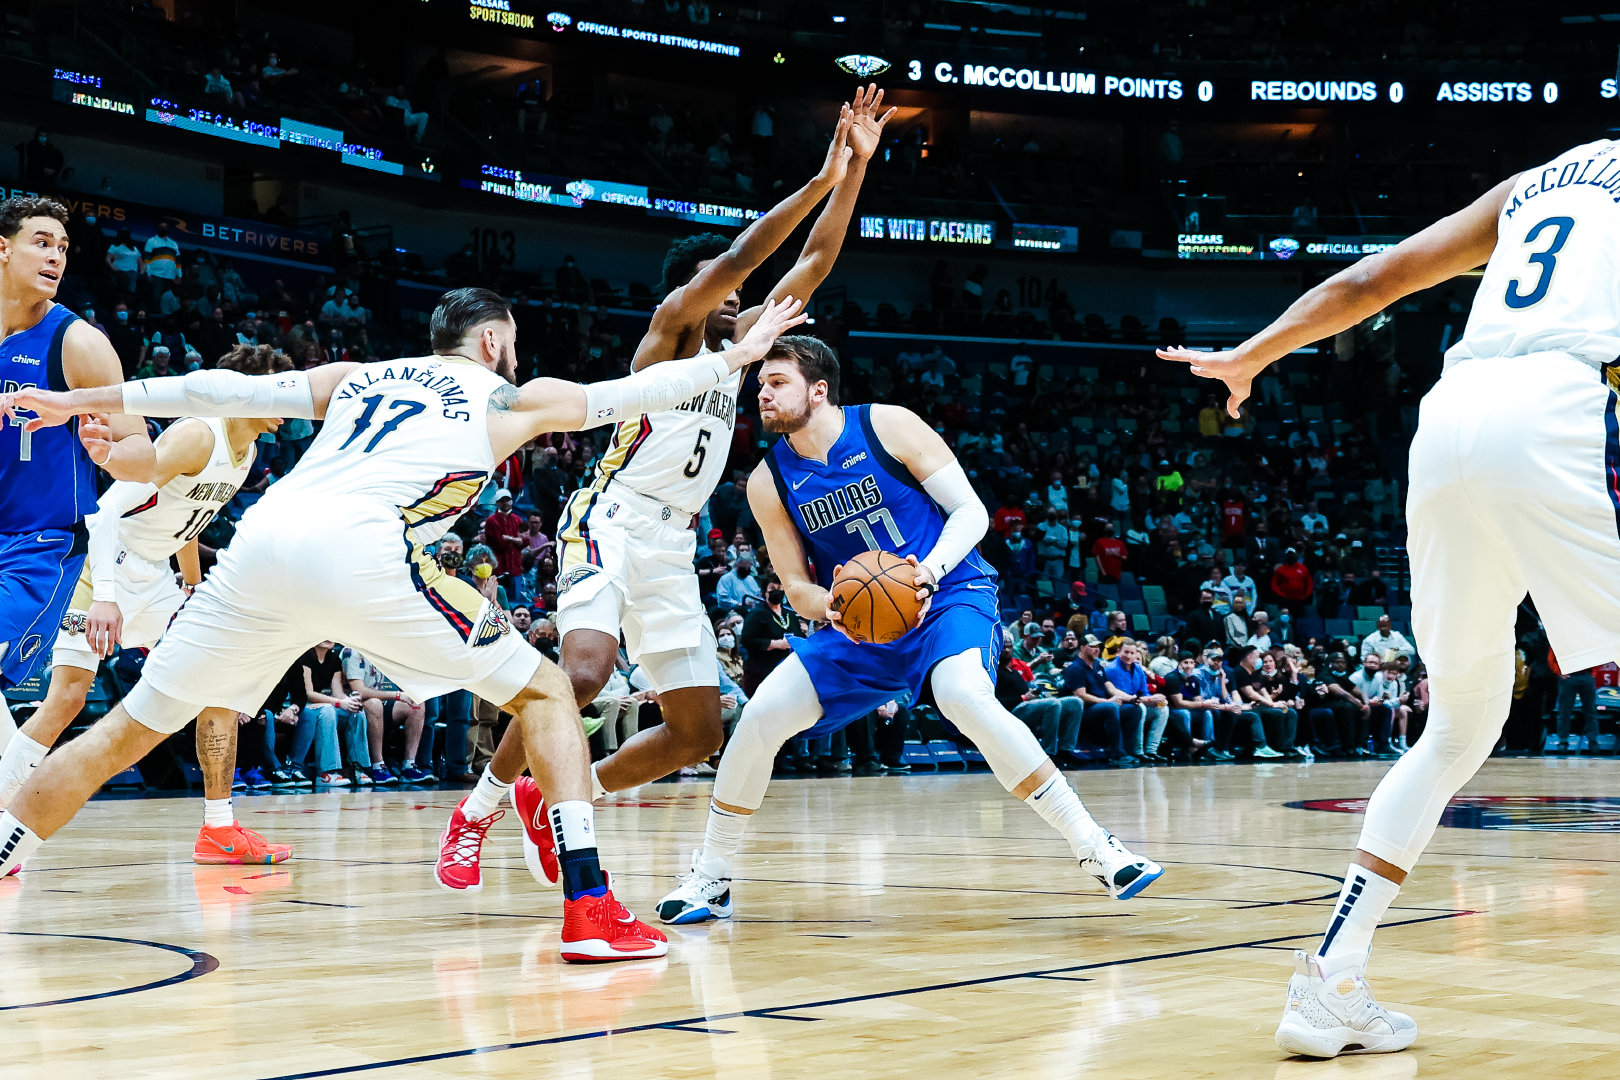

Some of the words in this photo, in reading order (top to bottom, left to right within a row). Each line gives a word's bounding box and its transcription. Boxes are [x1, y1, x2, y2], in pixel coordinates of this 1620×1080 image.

[470, 5, 534, 28] SPORTSBOOK
[577, 20, 620, 37] OFFICIAL
[621, 28, 658, 43] SPORTS
[659, 34, 698, 50] BETTING
[699, 40, 740, 57] PARTNER
[908, 59, 921, 81] 3
[934, 62, 958, 83] C.
[963, 64, 1096, 94] MCCOLLUM
[1104, 75, 1183, 100] POINTS
[1197, 80, 1214, 102] 0
[1250, 80, 1377, 102] REBOUNDS
[1389, 81, 1404, 103] 0
[1436, 81, 1533, 102] ASSISTS
[1543, 81, 1558, 103] 0
[601, 191, 652, 208] OFFICIAL
[654, 198, 698, 214] SPORTS
[699, 203, 744, 218] BETTING
[202, 223, 319, 256] BETRIVERS
[887, 218, 925, 241] WITH
[929, 220, 992, 245] CAESARS
[1177, 233, 1224, 245] CAESARS
[1306, 243, 1361, 254] OFFICIAL
[1504, 215, 1577, 309] 3
[11, 354, 41, 366] chime
[337, 393, 427, 453] 17
[684, 428, 711, 478] 5
[841, 451, 867, 470] chime
[185, 482, 218, 502] NEW
[798, 474, 883, 534] DALLAS
[173, 506, 215, 541] 10
[845, 507, 906, 551] 77
